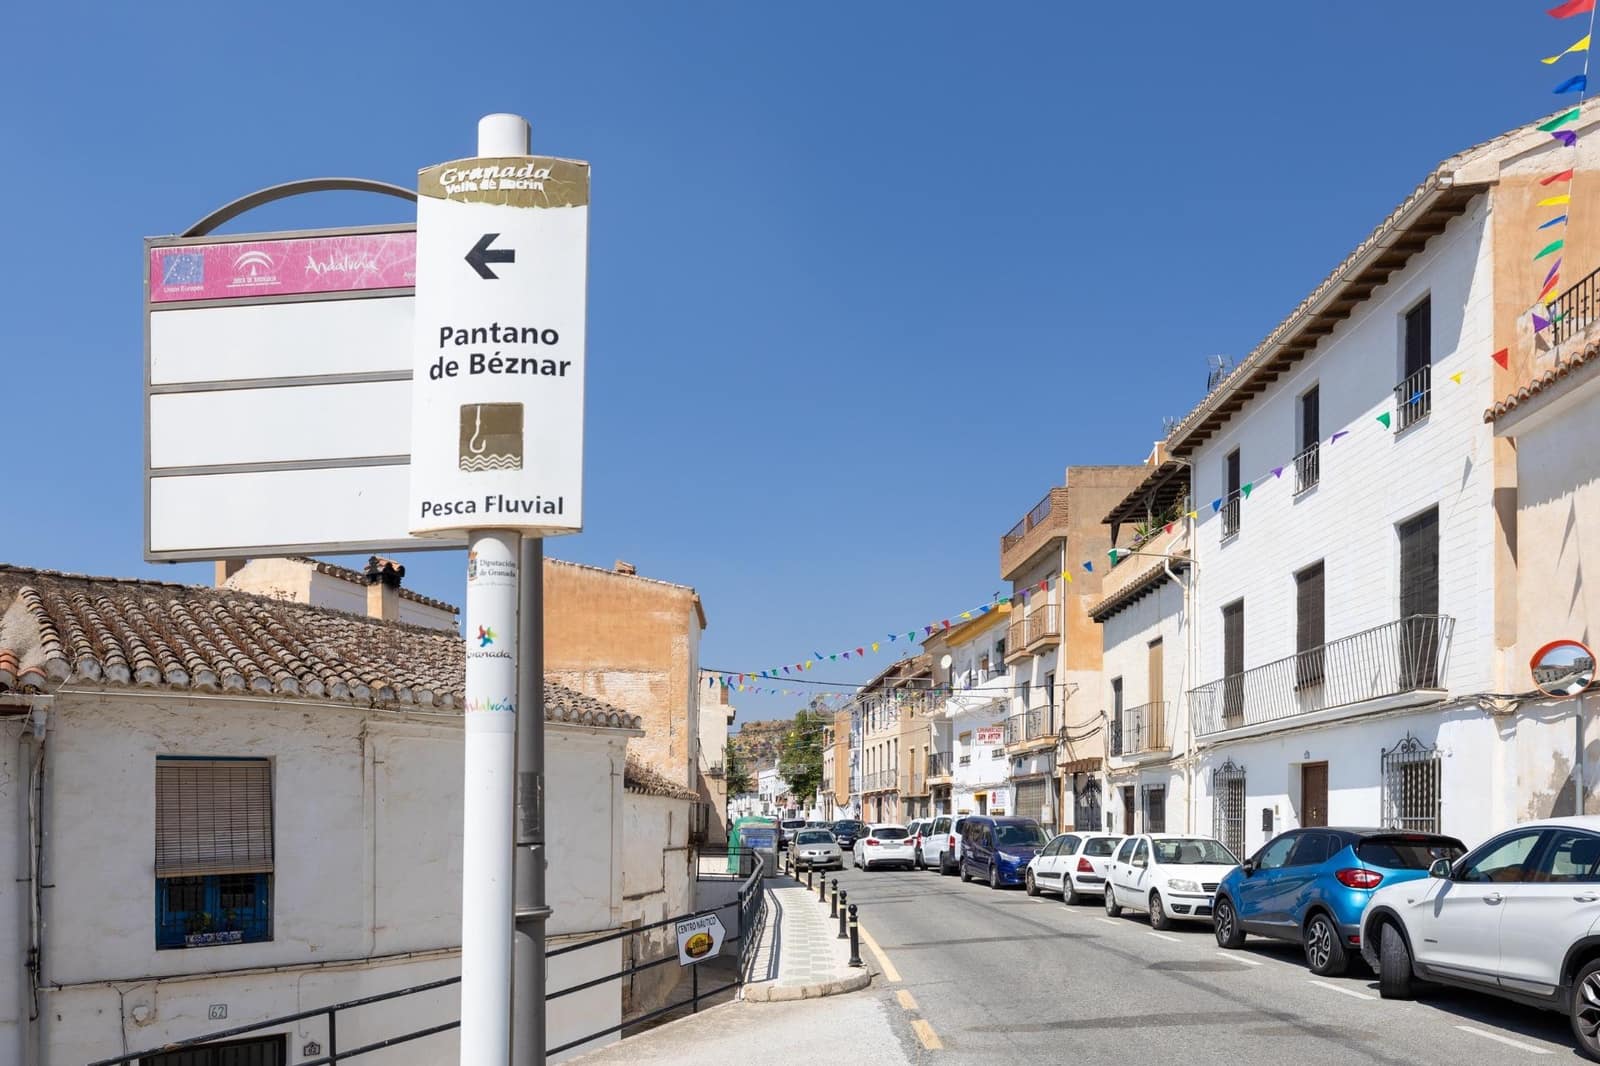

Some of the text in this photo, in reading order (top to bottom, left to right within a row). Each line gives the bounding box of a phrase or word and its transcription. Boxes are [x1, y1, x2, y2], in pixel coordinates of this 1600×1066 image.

[440, 164, 551, 185] Granada
[440, 322, 559, 348] Pantano
[429, 351, 571, 380] de Béznar
[421, 494, 564, 518] Pesca Fluvial
[480, 559, 516, 568] Diputación
[678, 921, 696, 934] CENTRO
[211, 1007, 225, 1018] 62
